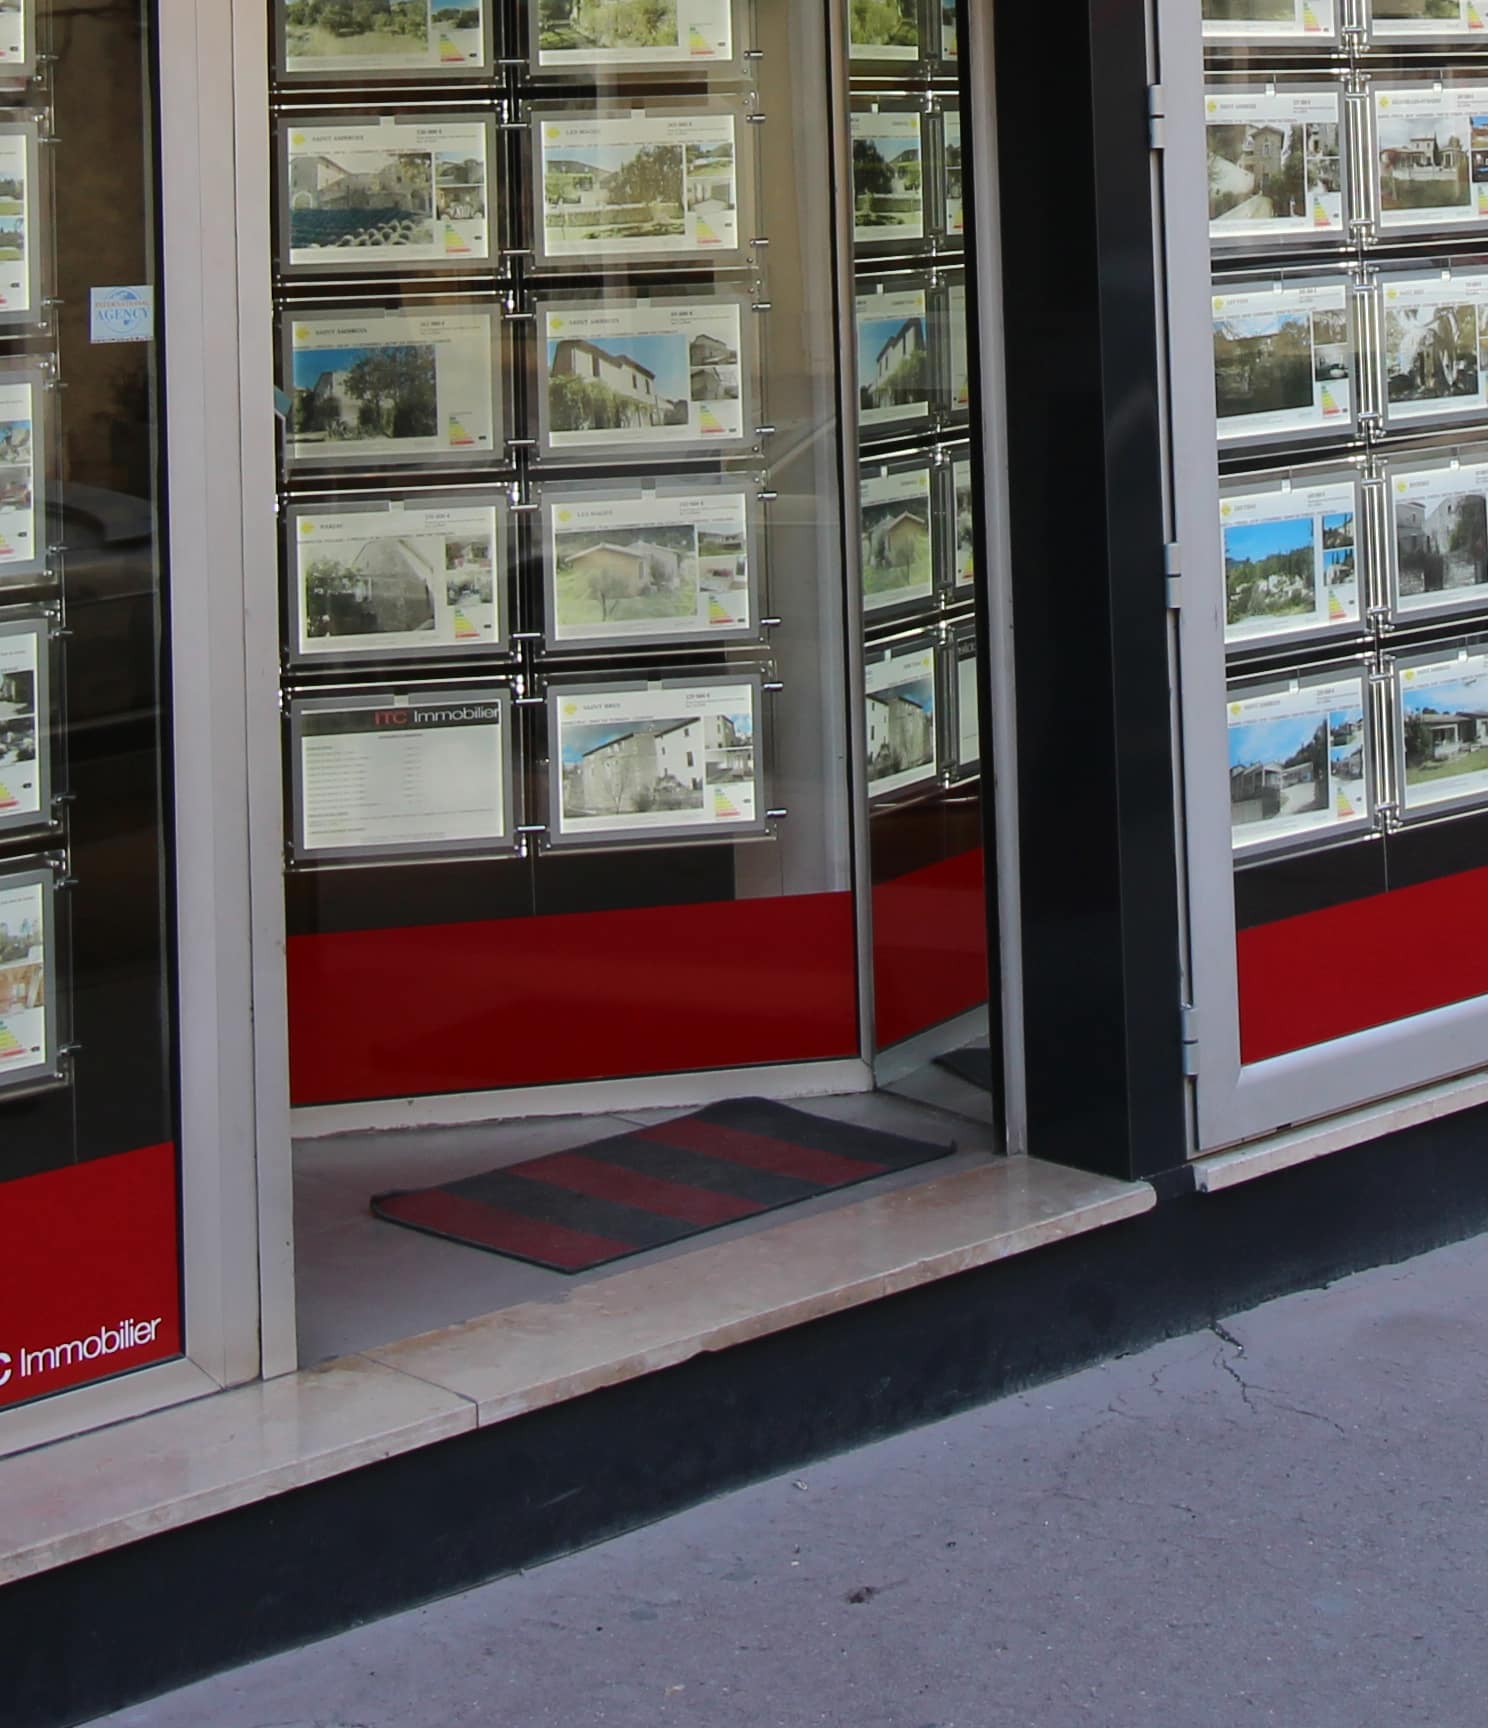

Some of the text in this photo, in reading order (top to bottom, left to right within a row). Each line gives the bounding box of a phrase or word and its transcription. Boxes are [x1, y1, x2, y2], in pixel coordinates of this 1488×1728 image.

[96, 305, 152, 321] AGENCY
[374, 706, 499, 726] ITC Immobilier
[20, 1317, 162, 1377] Immobilier
